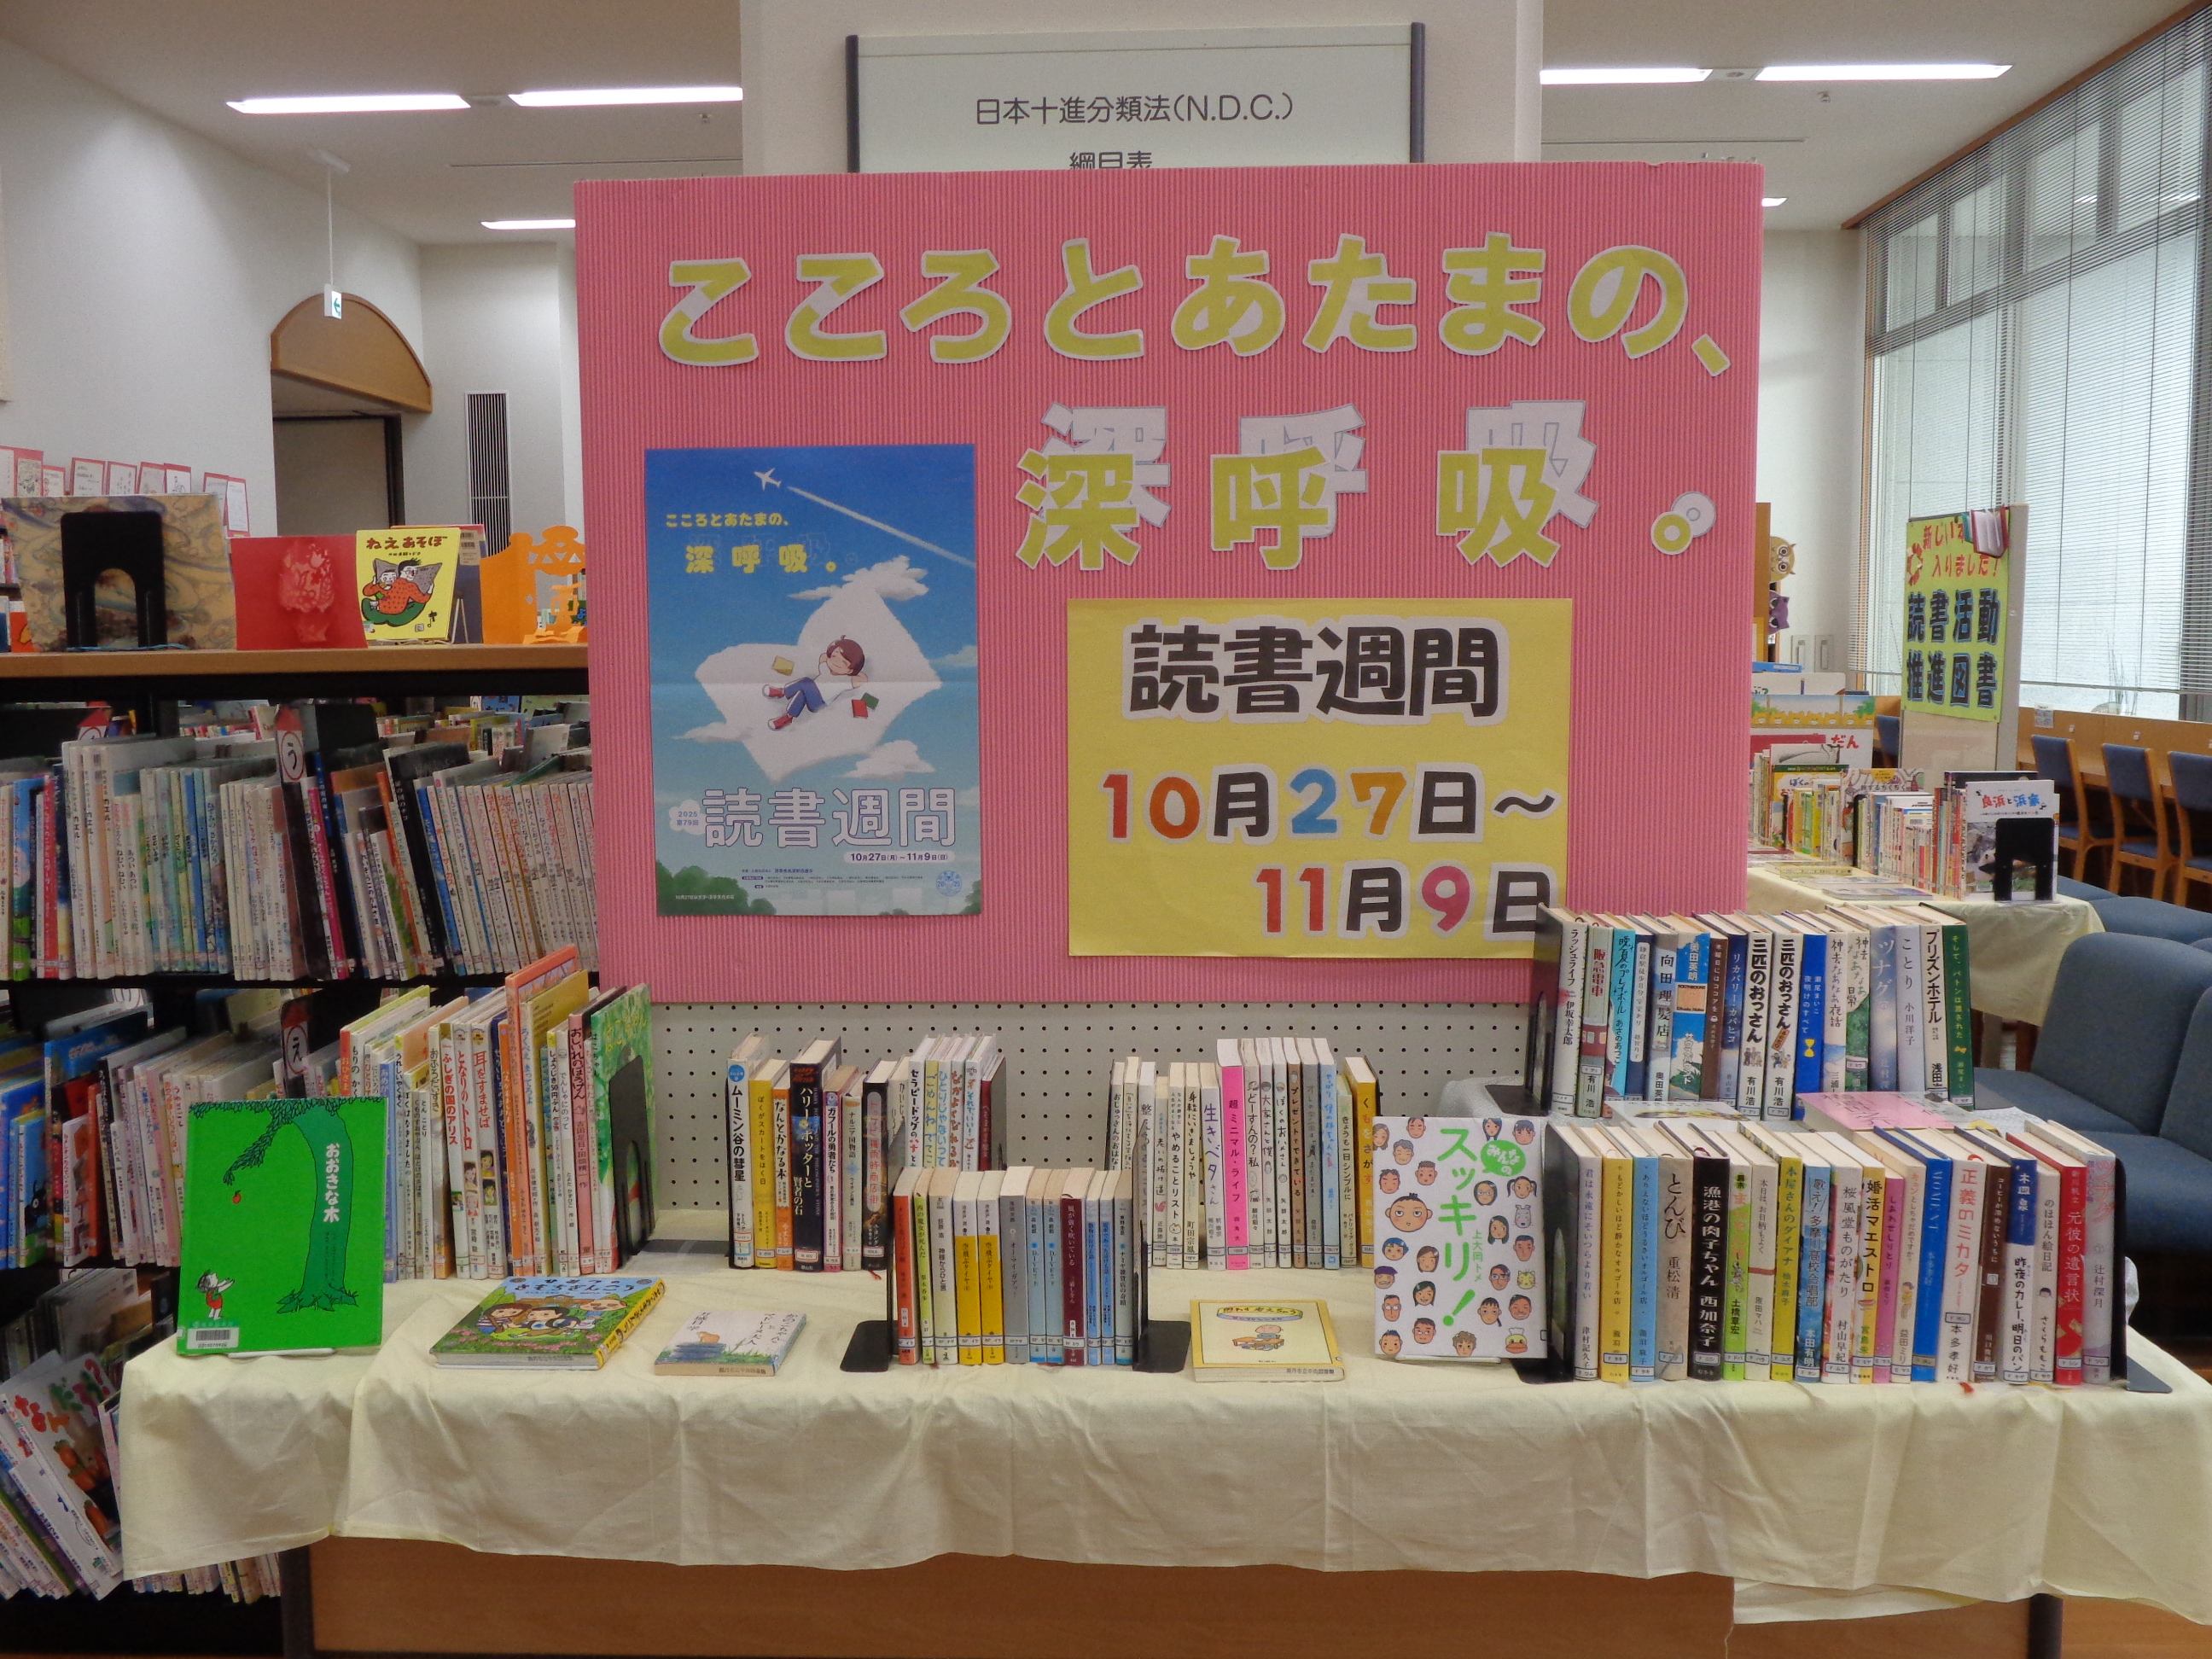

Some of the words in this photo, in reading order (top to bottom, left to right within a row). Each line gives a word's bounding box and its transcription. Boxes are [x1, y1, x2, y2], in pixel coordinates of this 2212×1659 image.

[975, 92, 1294, 125] 日本十進分類法(N.D.C.)
[658, 231, 1732, 377] こころとあたまの、
[666, 512, 789, 527] こころとあたまの、
[685, 544, 837, 574] 深呼吸。
[1906, 587, 2001, 645] 読書活動
[1127, 622, 1502, 720] 読書週間
[1905, 650, 1999, 709] 推進図書
[701, 787, 957, 849] 読書週間
[1568, 928, 1580, 987] ラッシュライフ
[1591, 948, 1606, 998] 阪急電車
[1687, 941, 1700, 981] 奥田英朗
[1776, 939, 1796, 1030] 三匹のおっさん
[1871, 939, 1896, 998] ツナグ
[1902, 938, 1913, 990] ことり
[1926, 931, 1943, 1024] プリズンホテル
[1656, 954, 1675, 1038] 向田理髪店
[1746, 938, 1768, 1044] 三匹のおっさん
[1802, 975, 1813, 1033] 夜明けのすべて
[1563, 1000, 1575, 1046] 伊坂幸太郎
[1904, 1002, 1915, 1045] 小川洋子
[429, 1049, 440, 1112] おふろだいすき
[442, 1053, 459, 1146] ふしぎの国のアリス
[457, 1051, 474, 1151] となりのトトロ
[473, 1050, 490, 1129] 耳をすませば
[560, 1072, 569, 1130] でんしゃにのって
[1745, 1076, 1756, 1106] 有川浩
[1773, 1076, 1784, 1106] 有川浩
[732, 1085, 747, 1182] ムーミン谷の彗星
[757, 1096, 766, 1185] ぼくがスカートをはく日
[775, 1100, 787, 1180] なんとかなる本
[827, 1107, 838, 1173] ガフールの勇者たち
[1203, 1103, 1220, 1206] 生きベタさん
[1228, 1099, 1240, 1202] 超ミニマル・ライフ
[1261, 1094, 1273, 1157] 大家さんと僕
[1362, 1097, 1374, 1186] くもをさがす
[323, 1142, 341, 1224] おおきな木
[793, 1176, 804, 1216] 賢者の石
[1171, 1134, 1181, 1220] やめることリスト
[1663, 1173, 1686, 1241] とんび
[2017, 1173, 2031, 1212] 木皿泉
[917, 1204, 927, 1259] 西の魔女が死んだ
[1068, 1205, 1077, 1266] 風が強く吹いている
[1437, 1127, 1478, 1327] スッキリ!
[1582, 1168, 1594, 1300] 君は永遠にそいつらより若い
[1700, 1185, 1722, 1287] 漁港の肉子ちゃん
[1757, 1179, 1768, 1254] 本日は、お日柄もよく
[1782, 1166, 1798, 1269] 本屋さんのダイアナ
[1837, 1186, 1858, 1298] 桜風堂ものがたり
[1861, 1179, 1883, 1294] 婚活マエストロ
[1953, 1168, 1978, 1278] 正義のミカタ
[2040, 1199, 2055, 1272] のほほん絵日記
[938, 1248, 947, 1292] 神様からひと言
[1472, 1230, 1483, 1283] 上大岡トメ
[1666, 1256, 1680, 1300] 重松清
[2064, 1212, 2083, 1304] 元彼の遺言状
[2093, 1264, 2104, 1309] 辻村深月
[1699, 1295, 1719, 1348] 西加奈子
[1730, 1298, 1742, 1336] 土橋章宏
[1754, 1296, 1764, 1325] 原田マハ
[1835, 1320, 1848, 1363] 村山早紀
[2011, 1257, 2028, 1371] 昨夜のカレー、明日のパン
[1804, 1329, 1815, 1367] 本田有明
[1899, 1329, 1909, 1365] 益田ミリ
[1947, 1324, 1962, 1374] 本多孝好
[2038, 1316, 2050, 1371] さくらももこ
